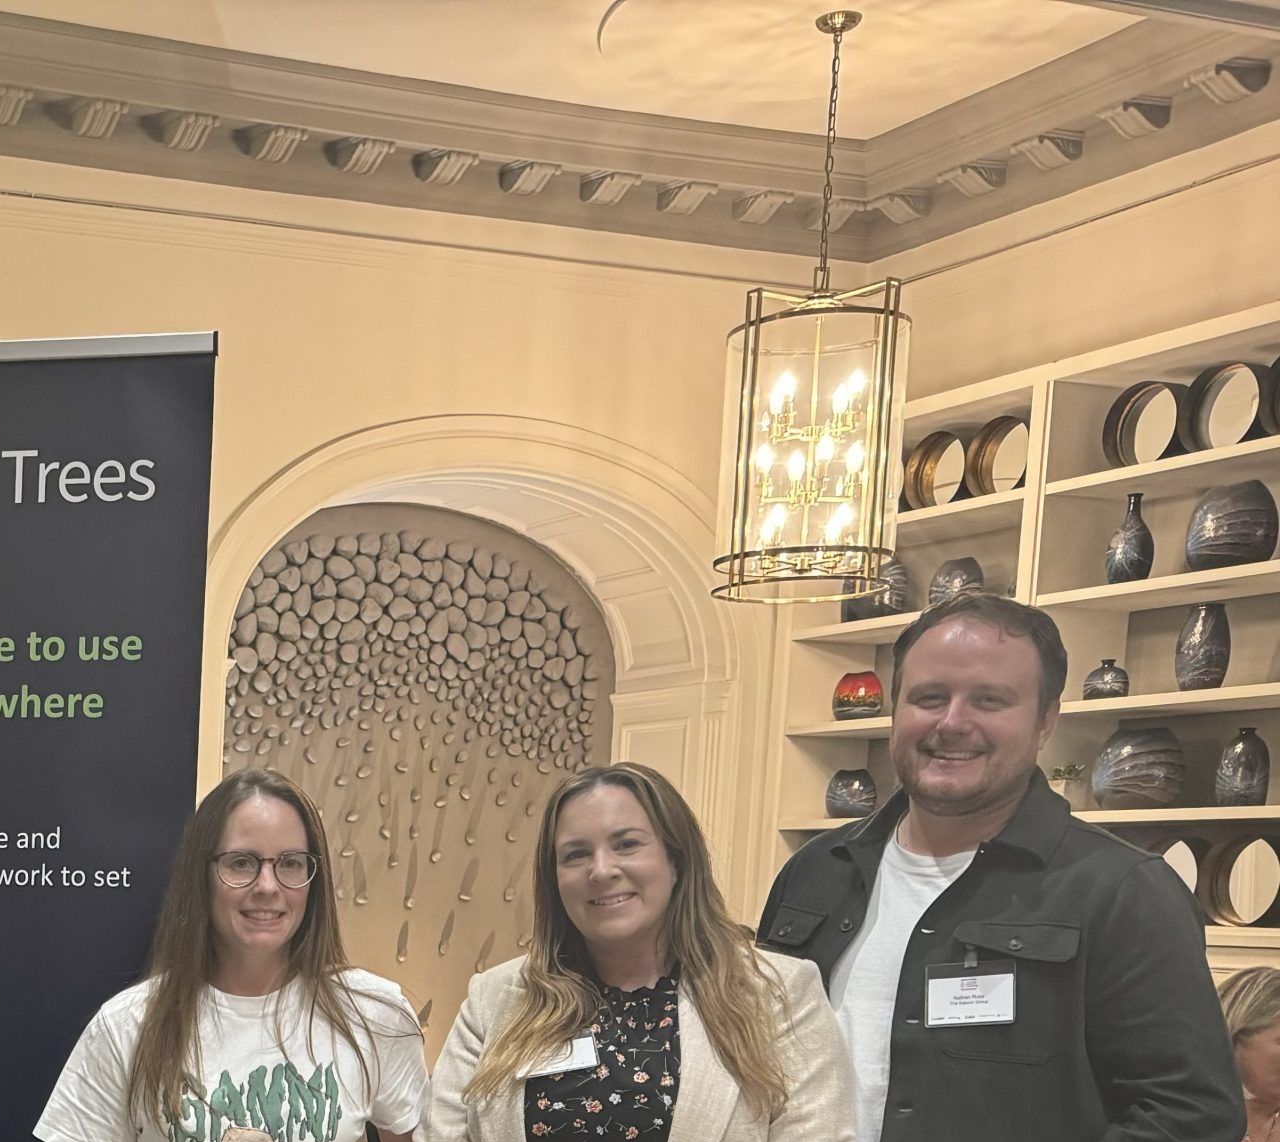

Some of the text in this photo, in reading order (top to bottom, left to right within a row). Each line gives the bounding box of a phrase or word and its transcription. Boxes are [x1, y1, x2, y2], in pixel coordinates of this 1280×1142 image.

[1, 449, 156, 504] Trees
[26, 631, 66, 662] to
[78, 635, 143, 661] use
[16, 826, 61, 849] and
[60, 866, 86, 887] to
[93, 867, 131, 888] set
